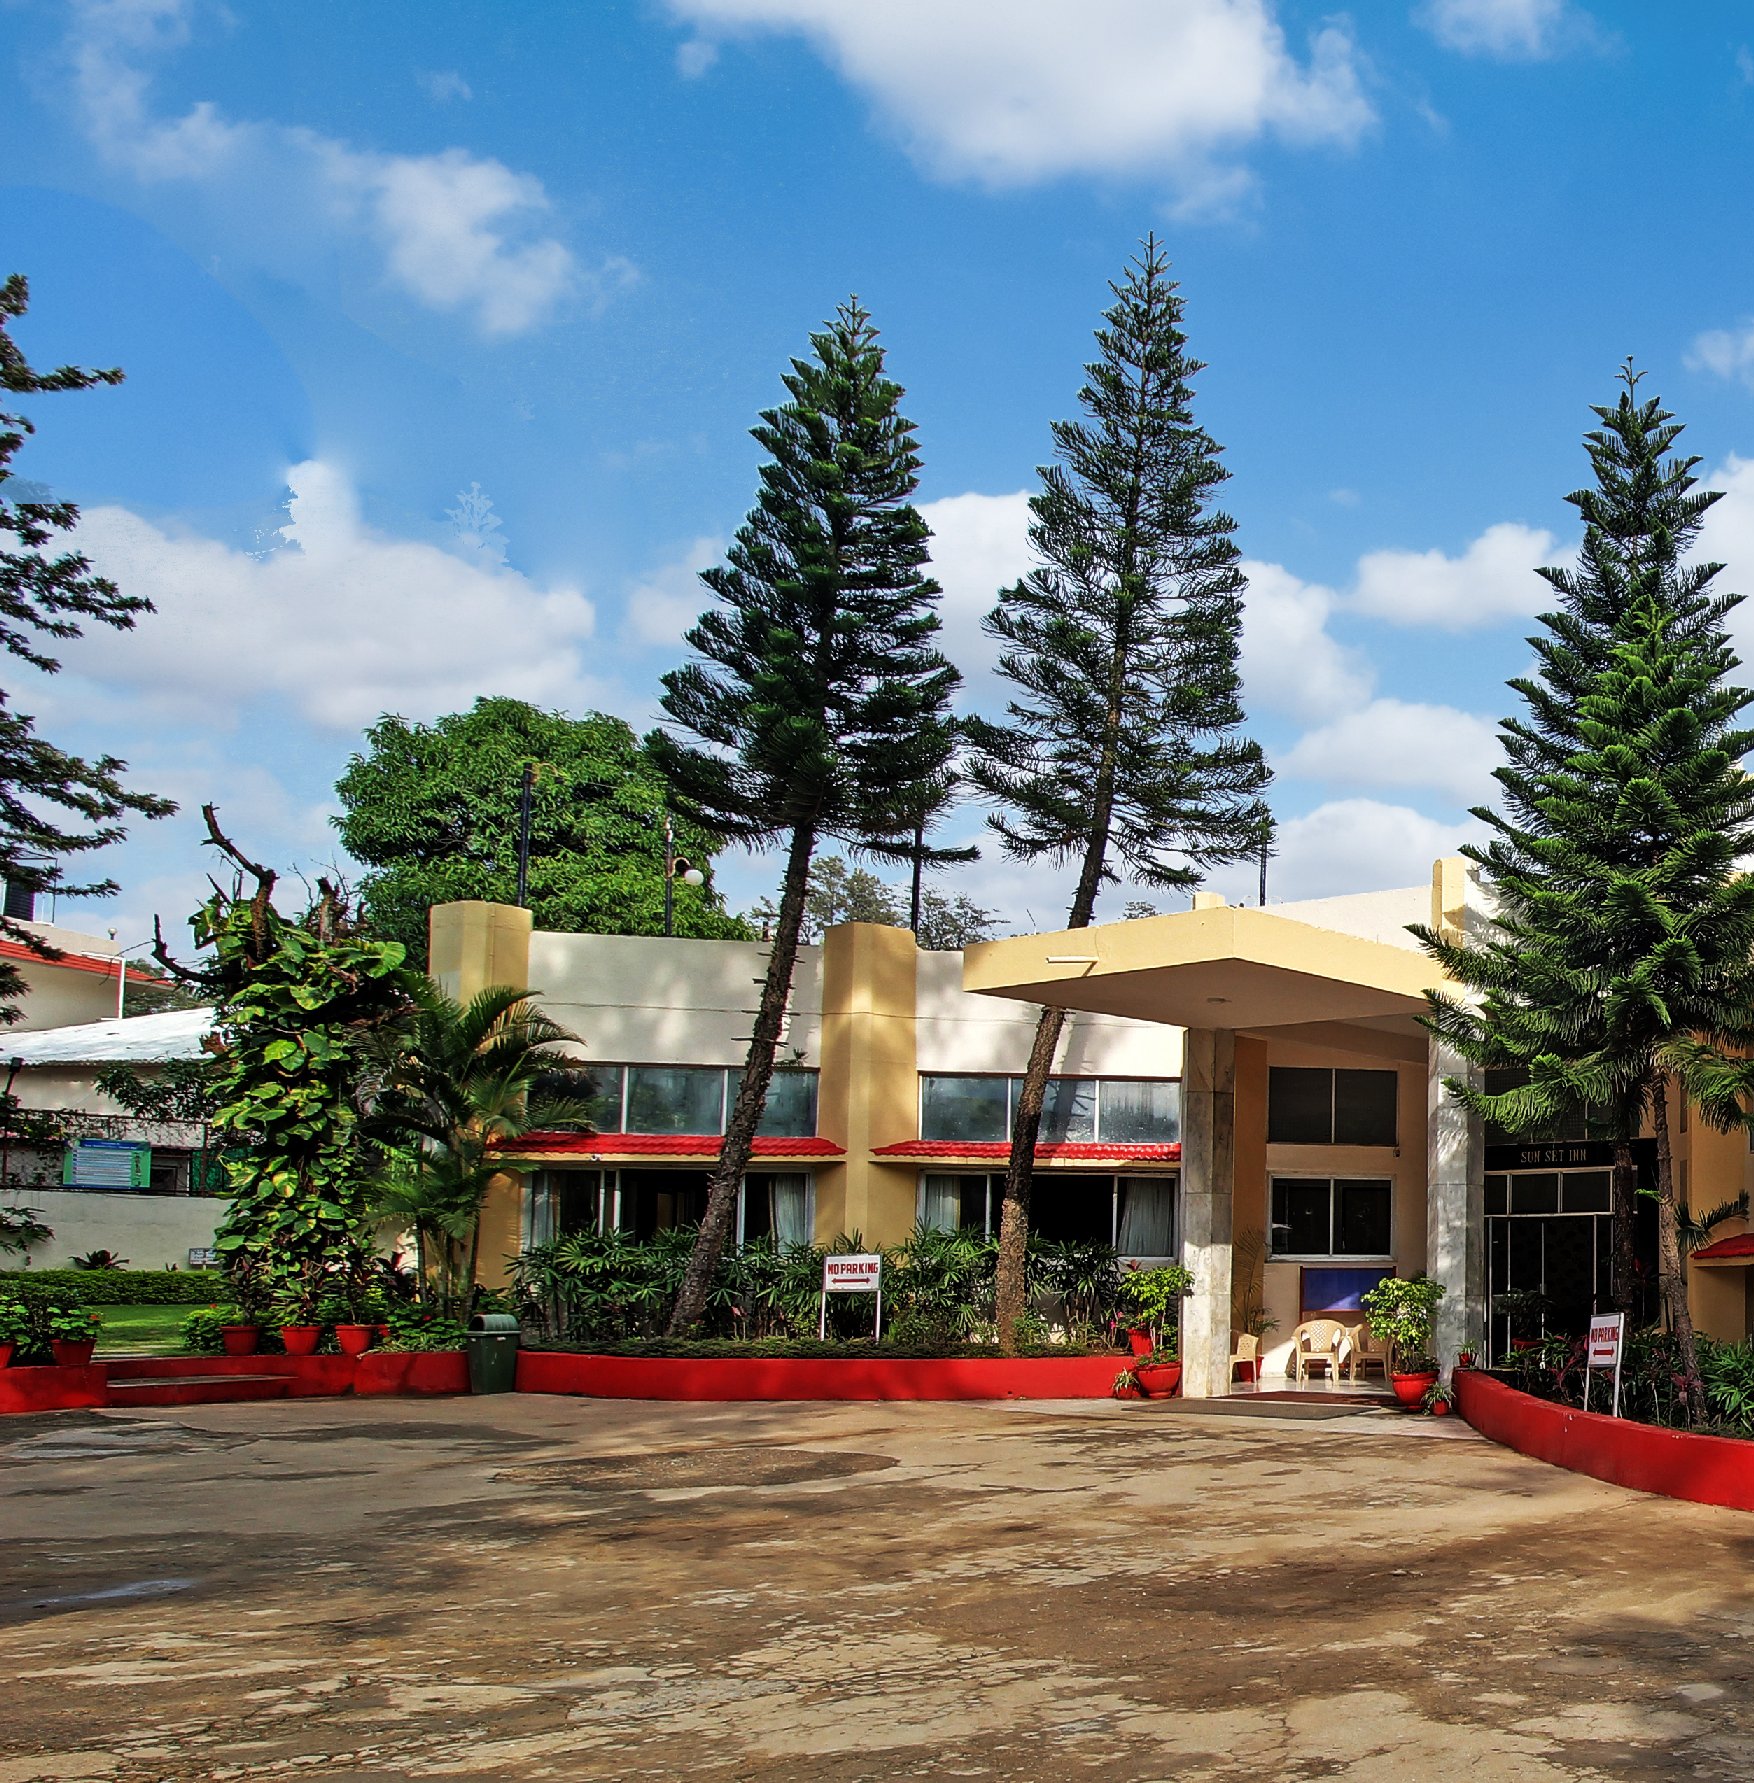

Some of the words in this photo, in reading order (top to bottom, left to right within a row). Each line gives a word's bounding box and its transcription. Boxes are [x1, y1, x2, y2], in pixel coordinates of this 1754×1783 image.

[1521, 1150, 1541, 1163] SUN
[1544, 1149, 1564, 1162] SET
[1569, 1148, 1587, 1162] INN
[828, 1263, 839, 1275] NO
[841, 1262, 878, 1274] PARKING
